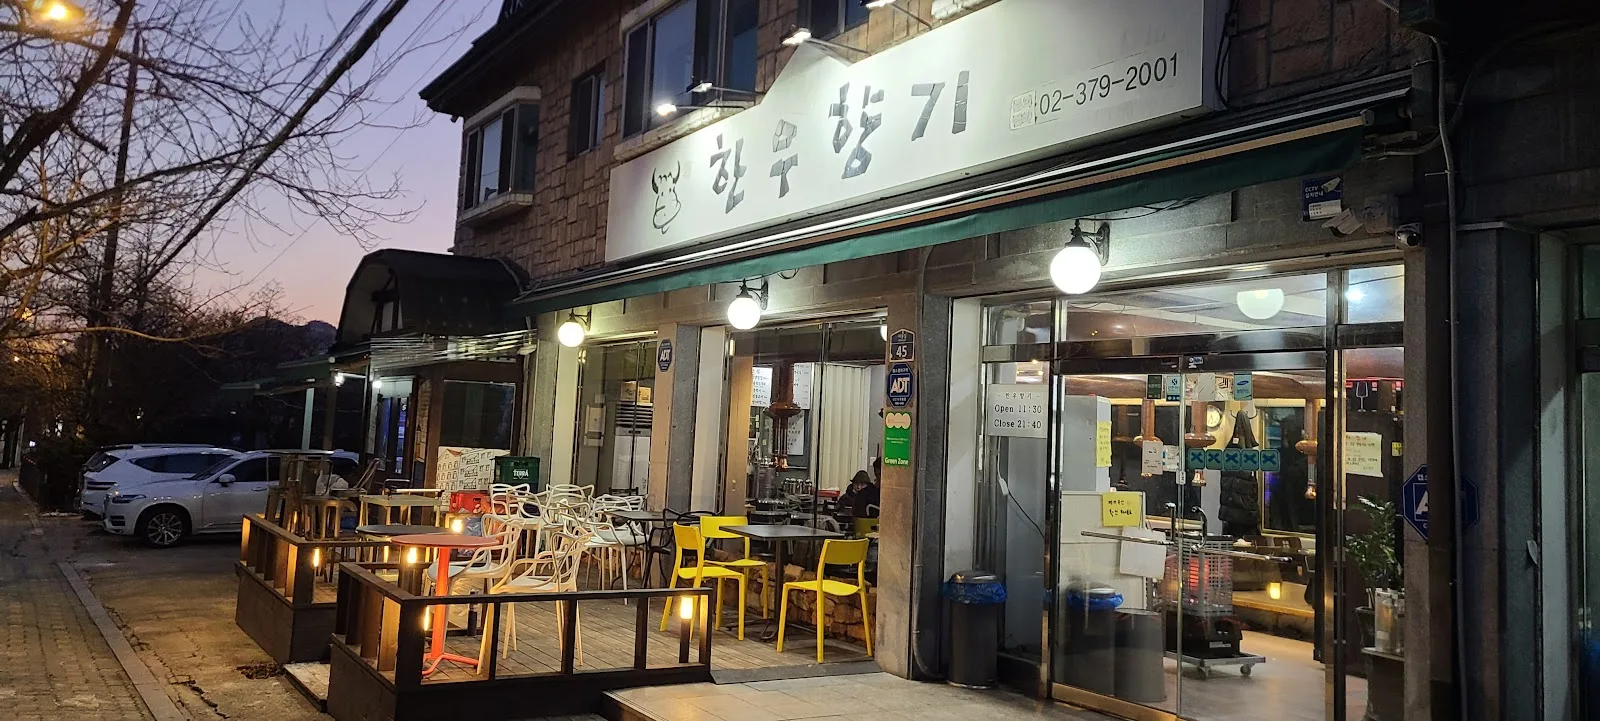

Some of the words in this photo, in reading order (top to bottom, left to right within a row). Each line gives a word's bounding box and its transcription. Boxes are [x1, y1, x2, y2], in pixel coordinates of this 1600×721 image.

[1039, 52, 1178, 115] 02-379-2001
[709, 70, 970, 215] 한우향기
[1305, 185, 1319, 193] CCTV
[660, 349, 671, 361] ADT
[896, 345, 908, 358] 45
[890, 377, 910, 393] ADT
[994, 404, 1014, 413] Open
[1018, 404, 1042, 413] 11:30
[994, 419, 1015, 428] Close
[1017, 420, 1042, 429] 21:40
[884, 457, 898, 465] Green
[898, 458, 909, 466] Zone
[513, 469, 529, 478] TERRA
